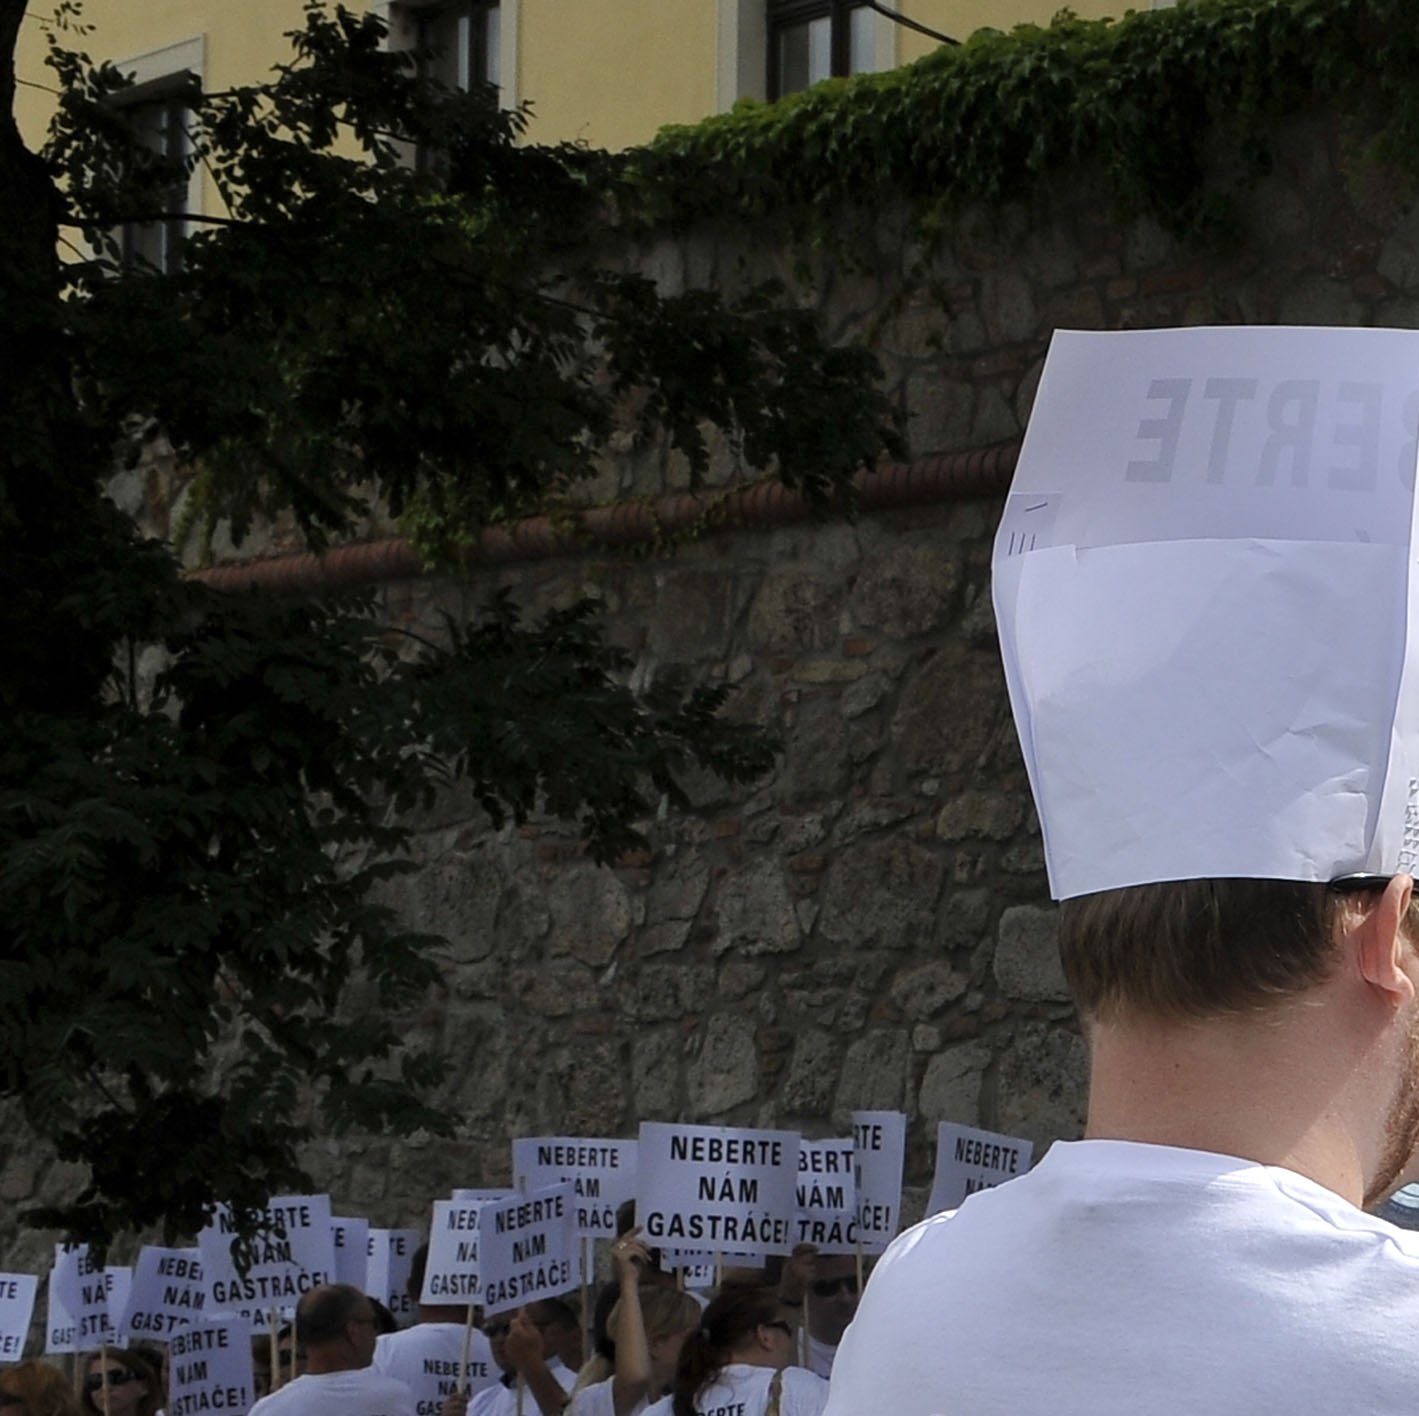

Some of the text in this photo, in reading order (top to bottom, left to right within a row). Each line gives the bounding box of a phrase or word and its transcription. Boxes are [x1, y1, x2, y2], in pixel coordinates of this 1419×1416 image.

[538, 1146, 619, 1168] NEBERTE
[671, 1135, 782, 1166] NEBERTE
[955, 1137, 1019, 1173] NEBERTE
[699, 1171, 757, 1203] NÁM
[495, 1196, 563, 1235] NEBERTE
[647, 1211, 789, 1244] GASTRÁČE!
